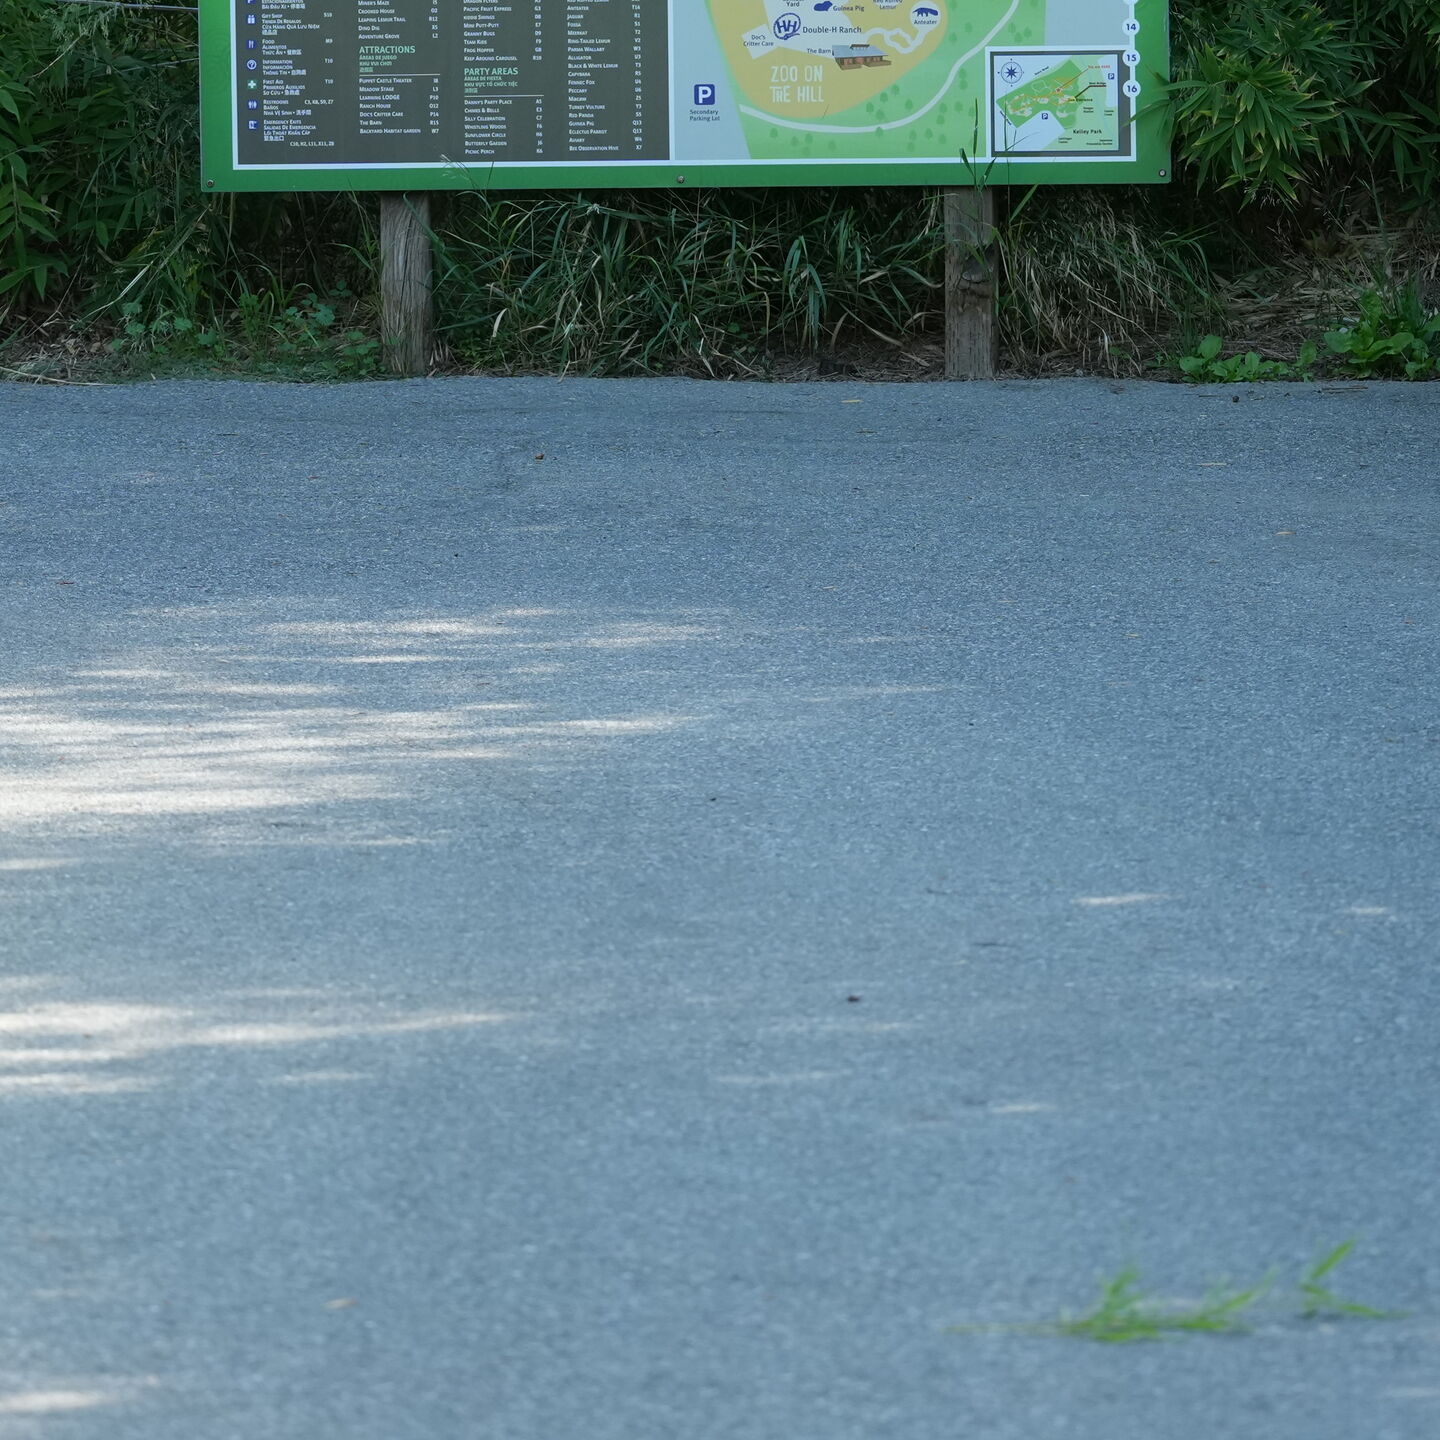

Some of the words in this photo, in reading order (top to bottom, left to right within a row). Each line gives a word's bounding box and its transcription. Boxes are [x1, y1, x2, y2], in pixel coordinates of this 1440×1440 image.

[802, 26, 838, 34] Double-H
[839, 26, 862, 34] Ranch
[359, 45, 416, 54] ATTRACTIONS
[464, 67, 490, 76] PARTY
[491, 67, 519, 75] AREAS
[698, 86, 712, 103] P
